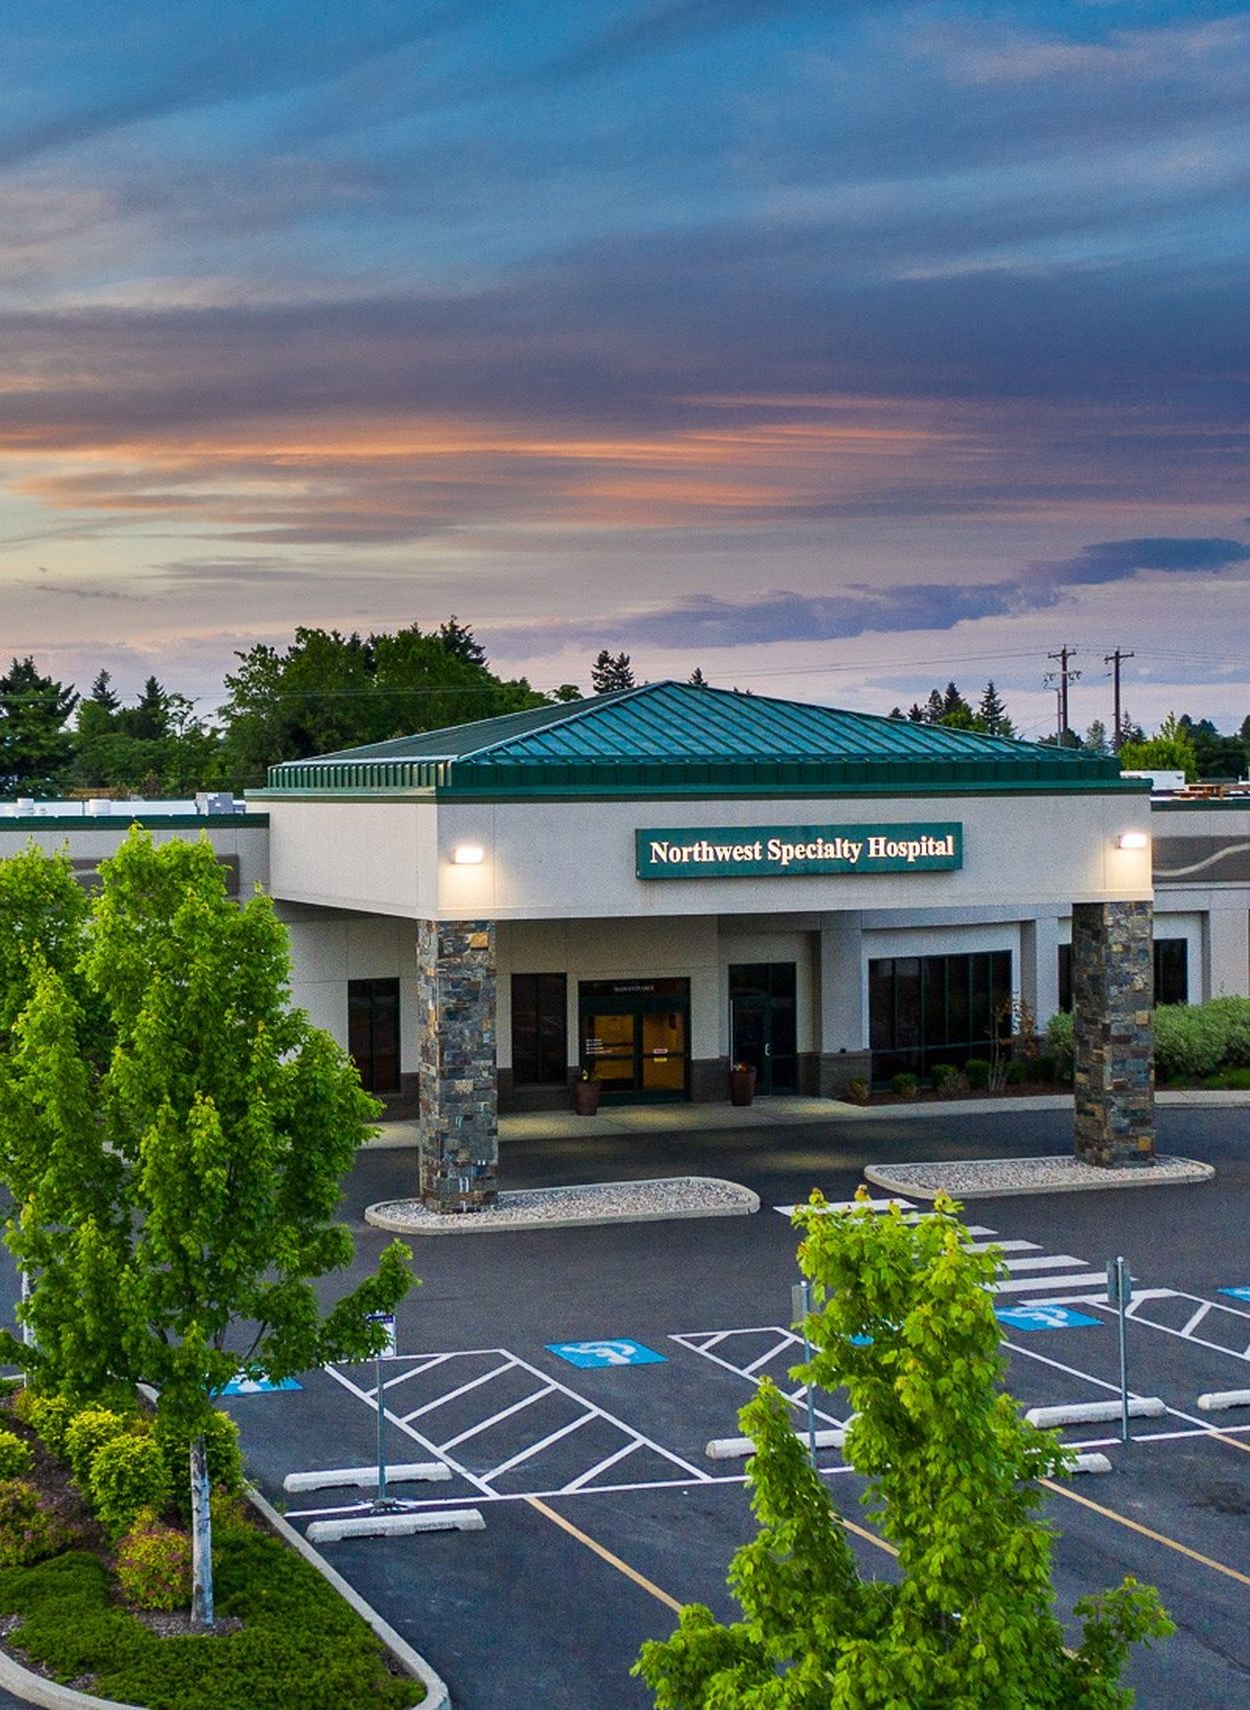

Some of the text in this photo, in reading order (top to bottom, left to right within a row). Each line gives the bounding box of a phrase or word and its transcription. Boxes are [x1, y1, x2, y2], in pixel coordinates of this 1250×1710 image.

[649, 835, 955, 865] Northwest Specialty Hospital
